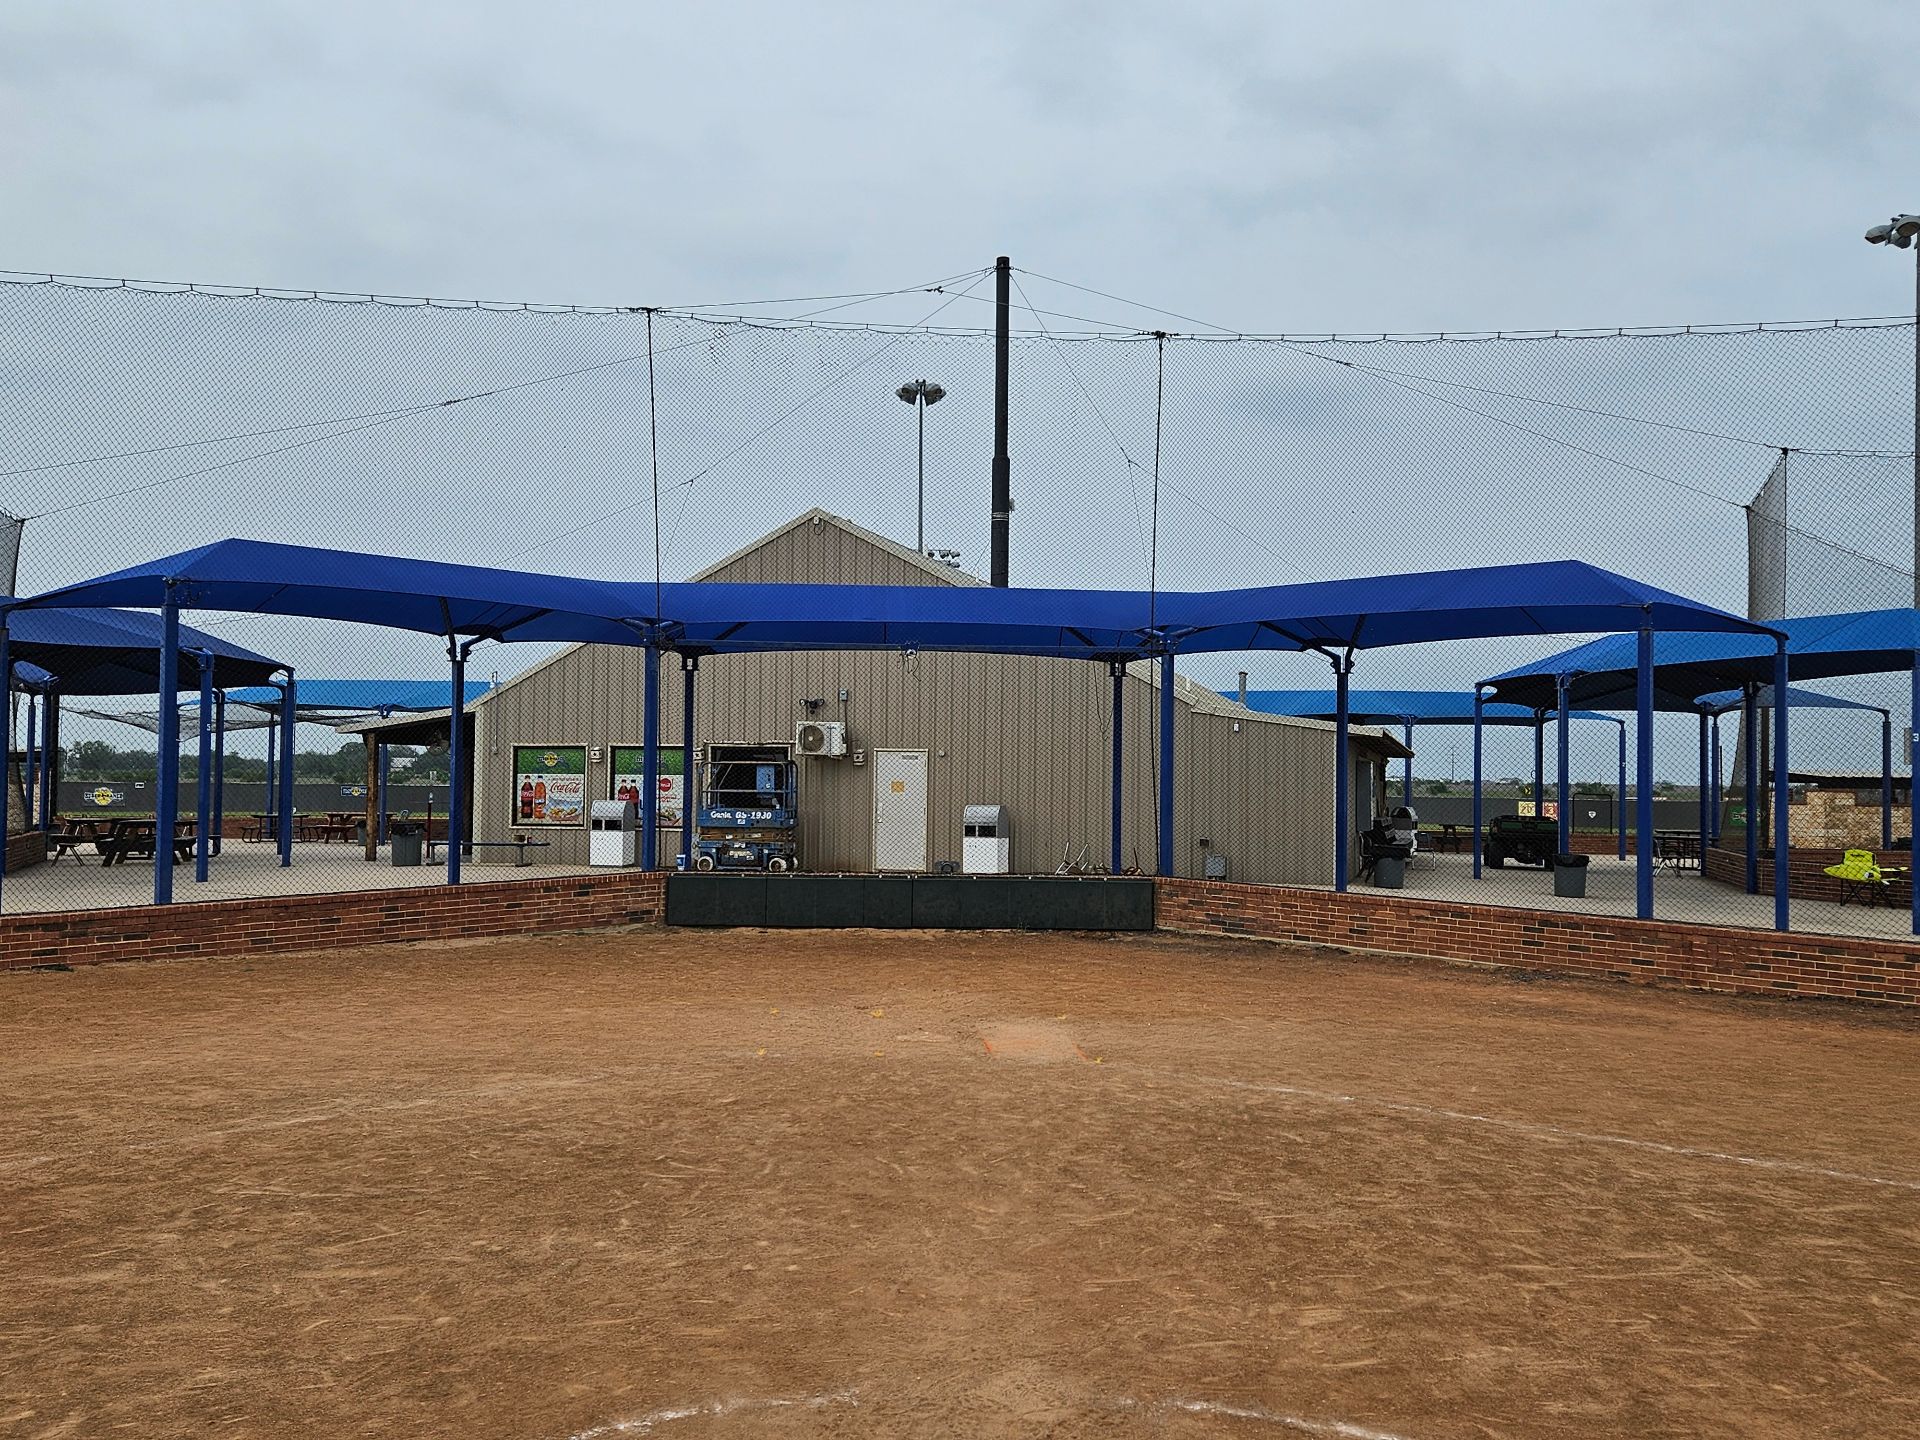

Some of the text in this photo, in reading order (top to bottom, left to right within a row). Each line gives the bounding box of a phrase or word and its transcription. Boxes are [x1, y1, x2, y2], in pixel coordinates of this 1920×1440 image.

[1912, 733, 1919, 742] 3
[710, 811, 772, 819] Genie GS-1930
